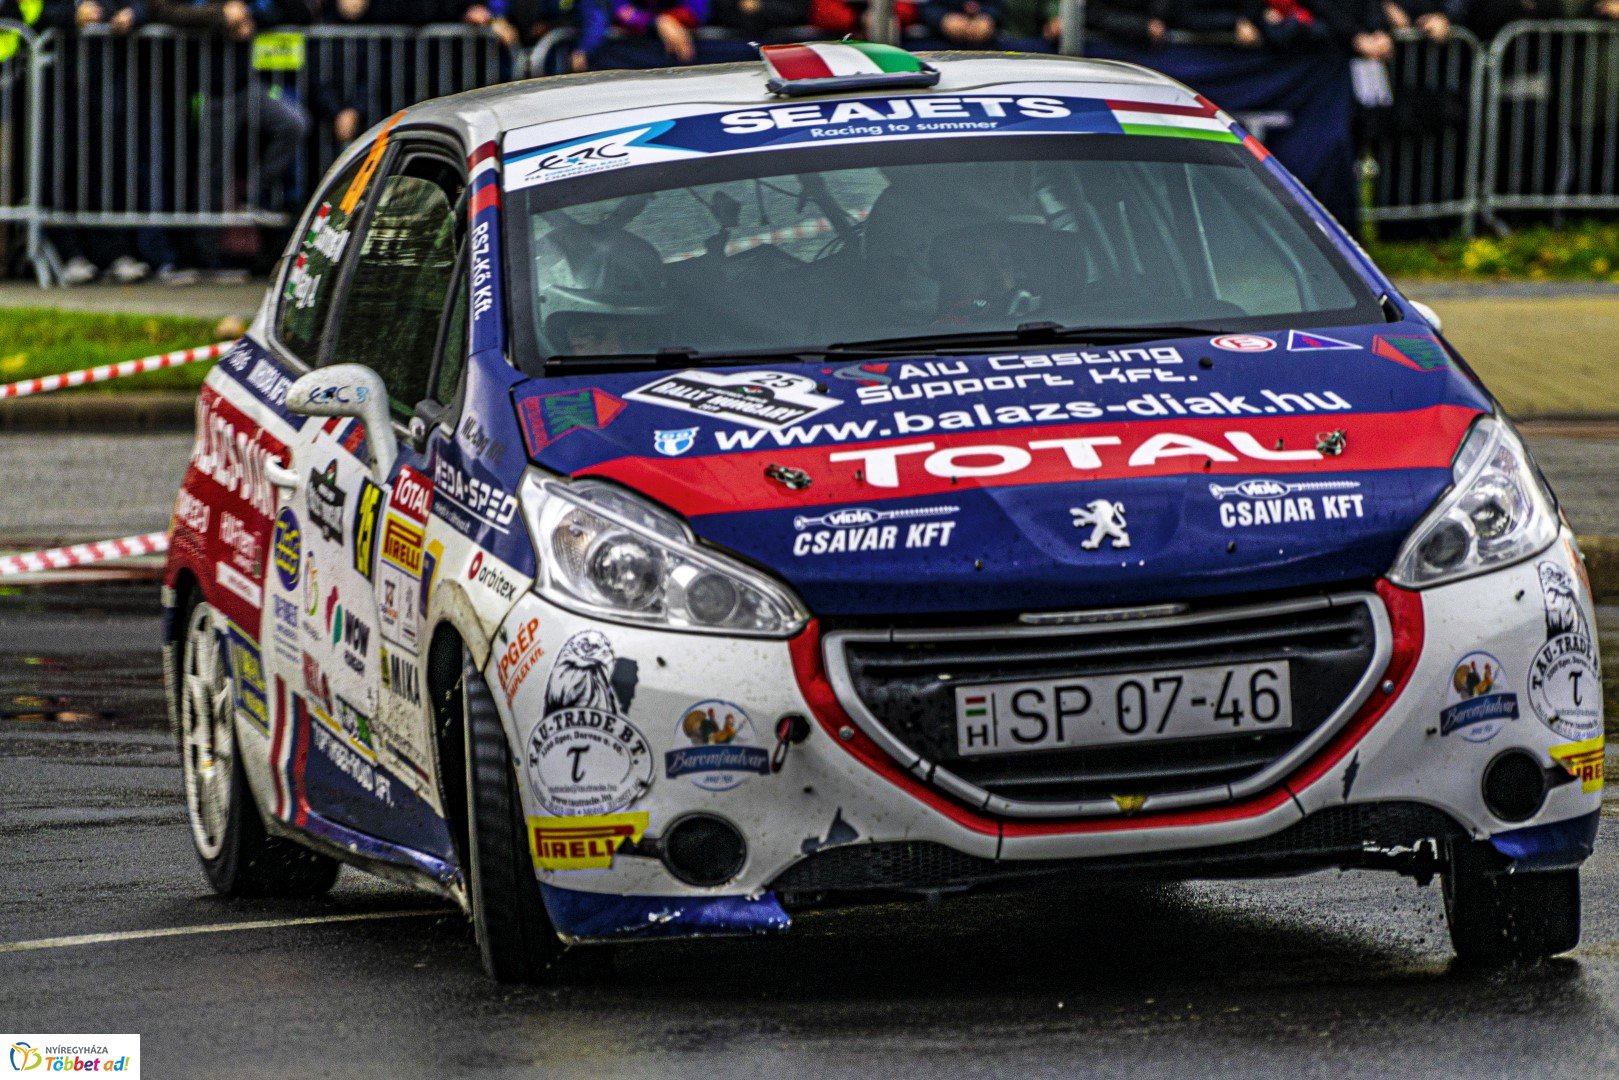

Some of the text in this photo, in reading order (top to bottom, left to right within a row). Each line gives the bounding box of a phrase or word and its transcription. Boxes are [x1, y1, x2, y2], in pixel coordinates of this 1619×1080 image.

[720, 97, 1072, 134] SEAJETS
[810, 121, 998, 138] Racing to summer
[988, 346, 1184, 370] Casting
[752, 373, 801, 388] 25
[856, 367, 1198, 405] Support Kft.
[650, 382, 707, 400] RALLY
[708, 394, 804, 421] HUNGARY
[713, 389, 1353, 452] www.balazs-diak.hu
[829, 430, 1325, 488] TOTAL
[394, 468, 431, 517] TOTAL
[1219, 494, 1364, 529] CSAVAR KFT
[384, 518, 423, 572] PIRELLI
[793, 521, 956, 557] CSAVAR KFT
[478, 565, 517, 601] orbitex
[966, 668, 1281, 747] H SP 07-46
[529, 709, 617, 768] TAU-TRADE
